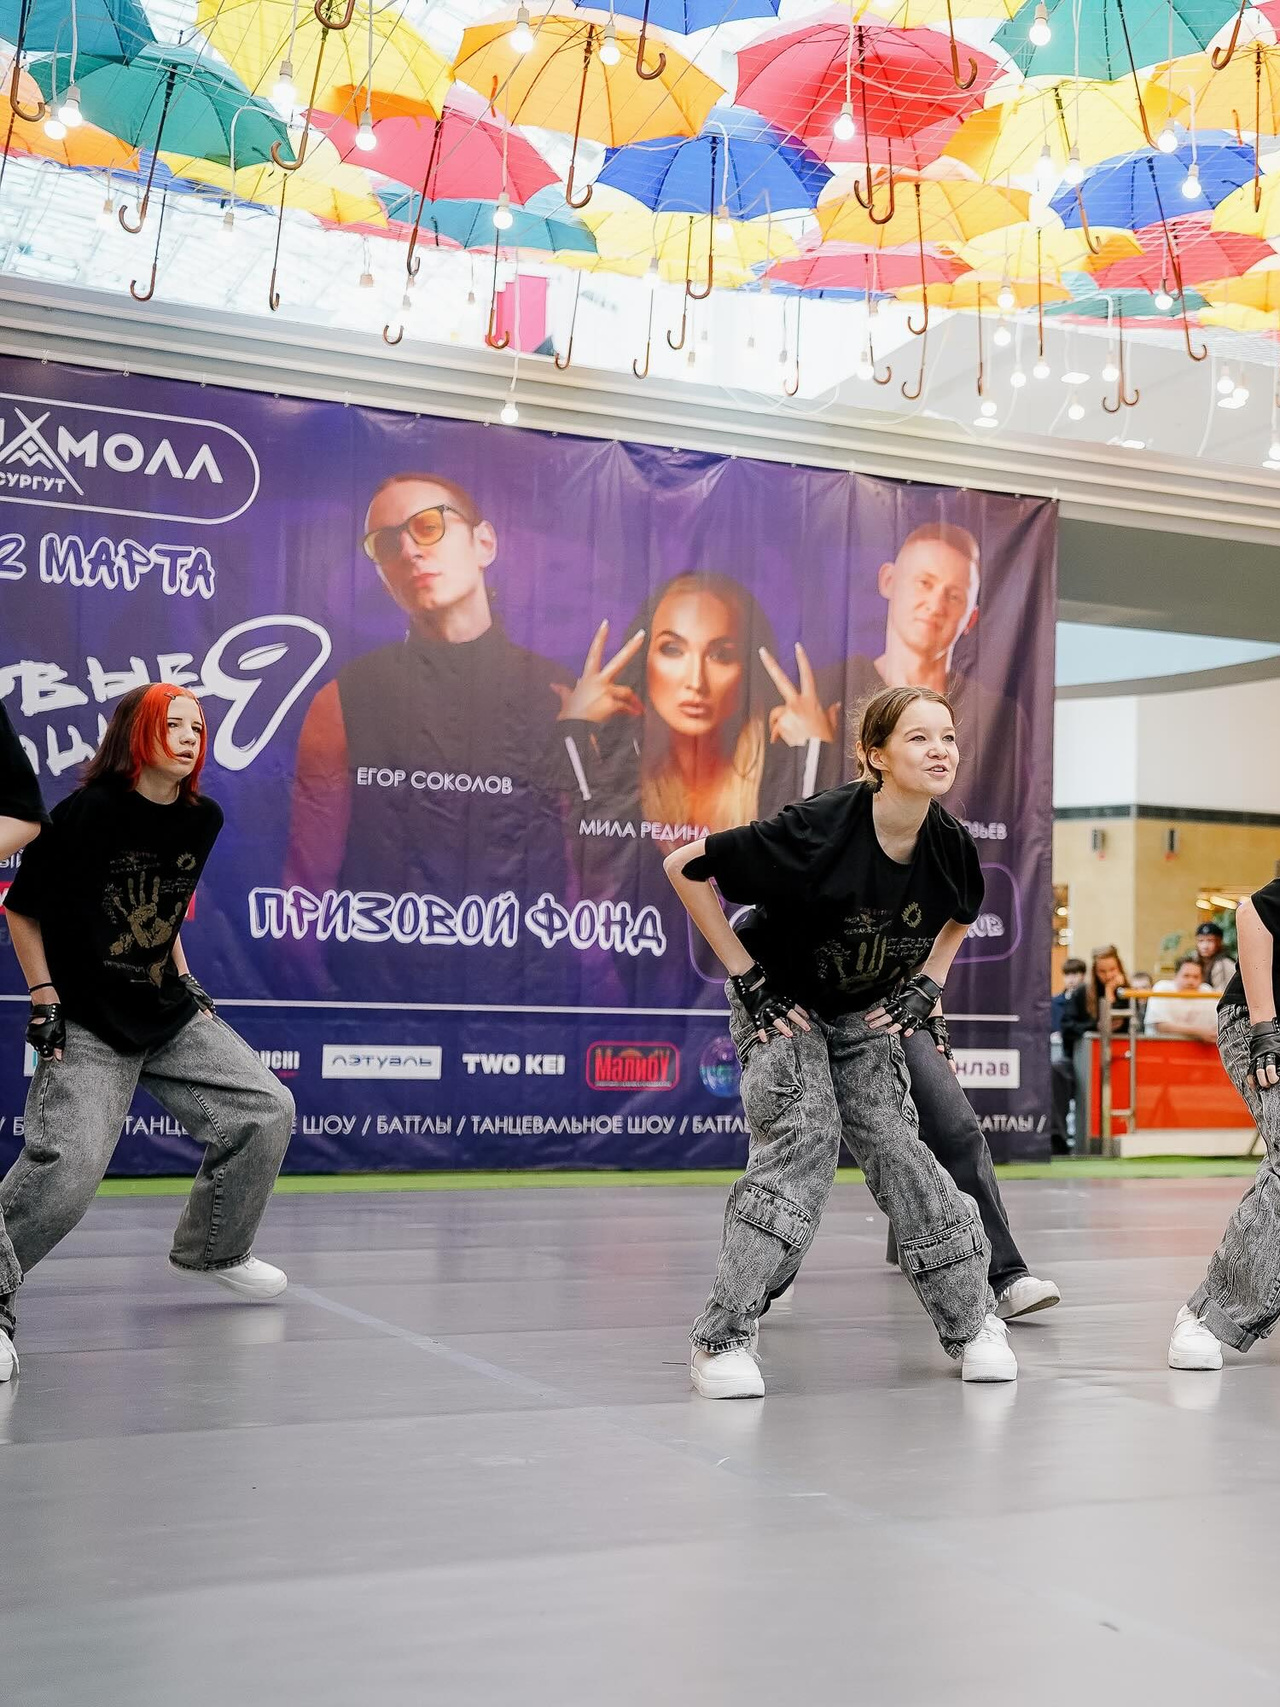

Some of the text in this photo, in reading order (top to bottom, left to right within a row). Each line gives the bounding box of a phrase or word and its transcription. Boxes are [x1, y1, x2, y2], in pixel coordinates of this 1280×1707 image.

[57, 425, 224, 484] МОЛЛ
[40, 532, 215, 600] МАРТА
[357, 766, 513, 795] ЕГОР СОКОЛОВ
[579, 818, 637, 839] МИЛА
[248, 885, 667, 956] ПРИЗОВОЙ ФОНД
[462, 1053, 566, 1075] TWO KEI
[302, 1114, 356, 1136] ШОУ
[377, 1114, 451, 1136] БАТТЛЫ
[471, 1114, 623, 1136] ТАНЦЕВАЛЬНОЕ
[627, 1114, 676, 1135] ШОУ
